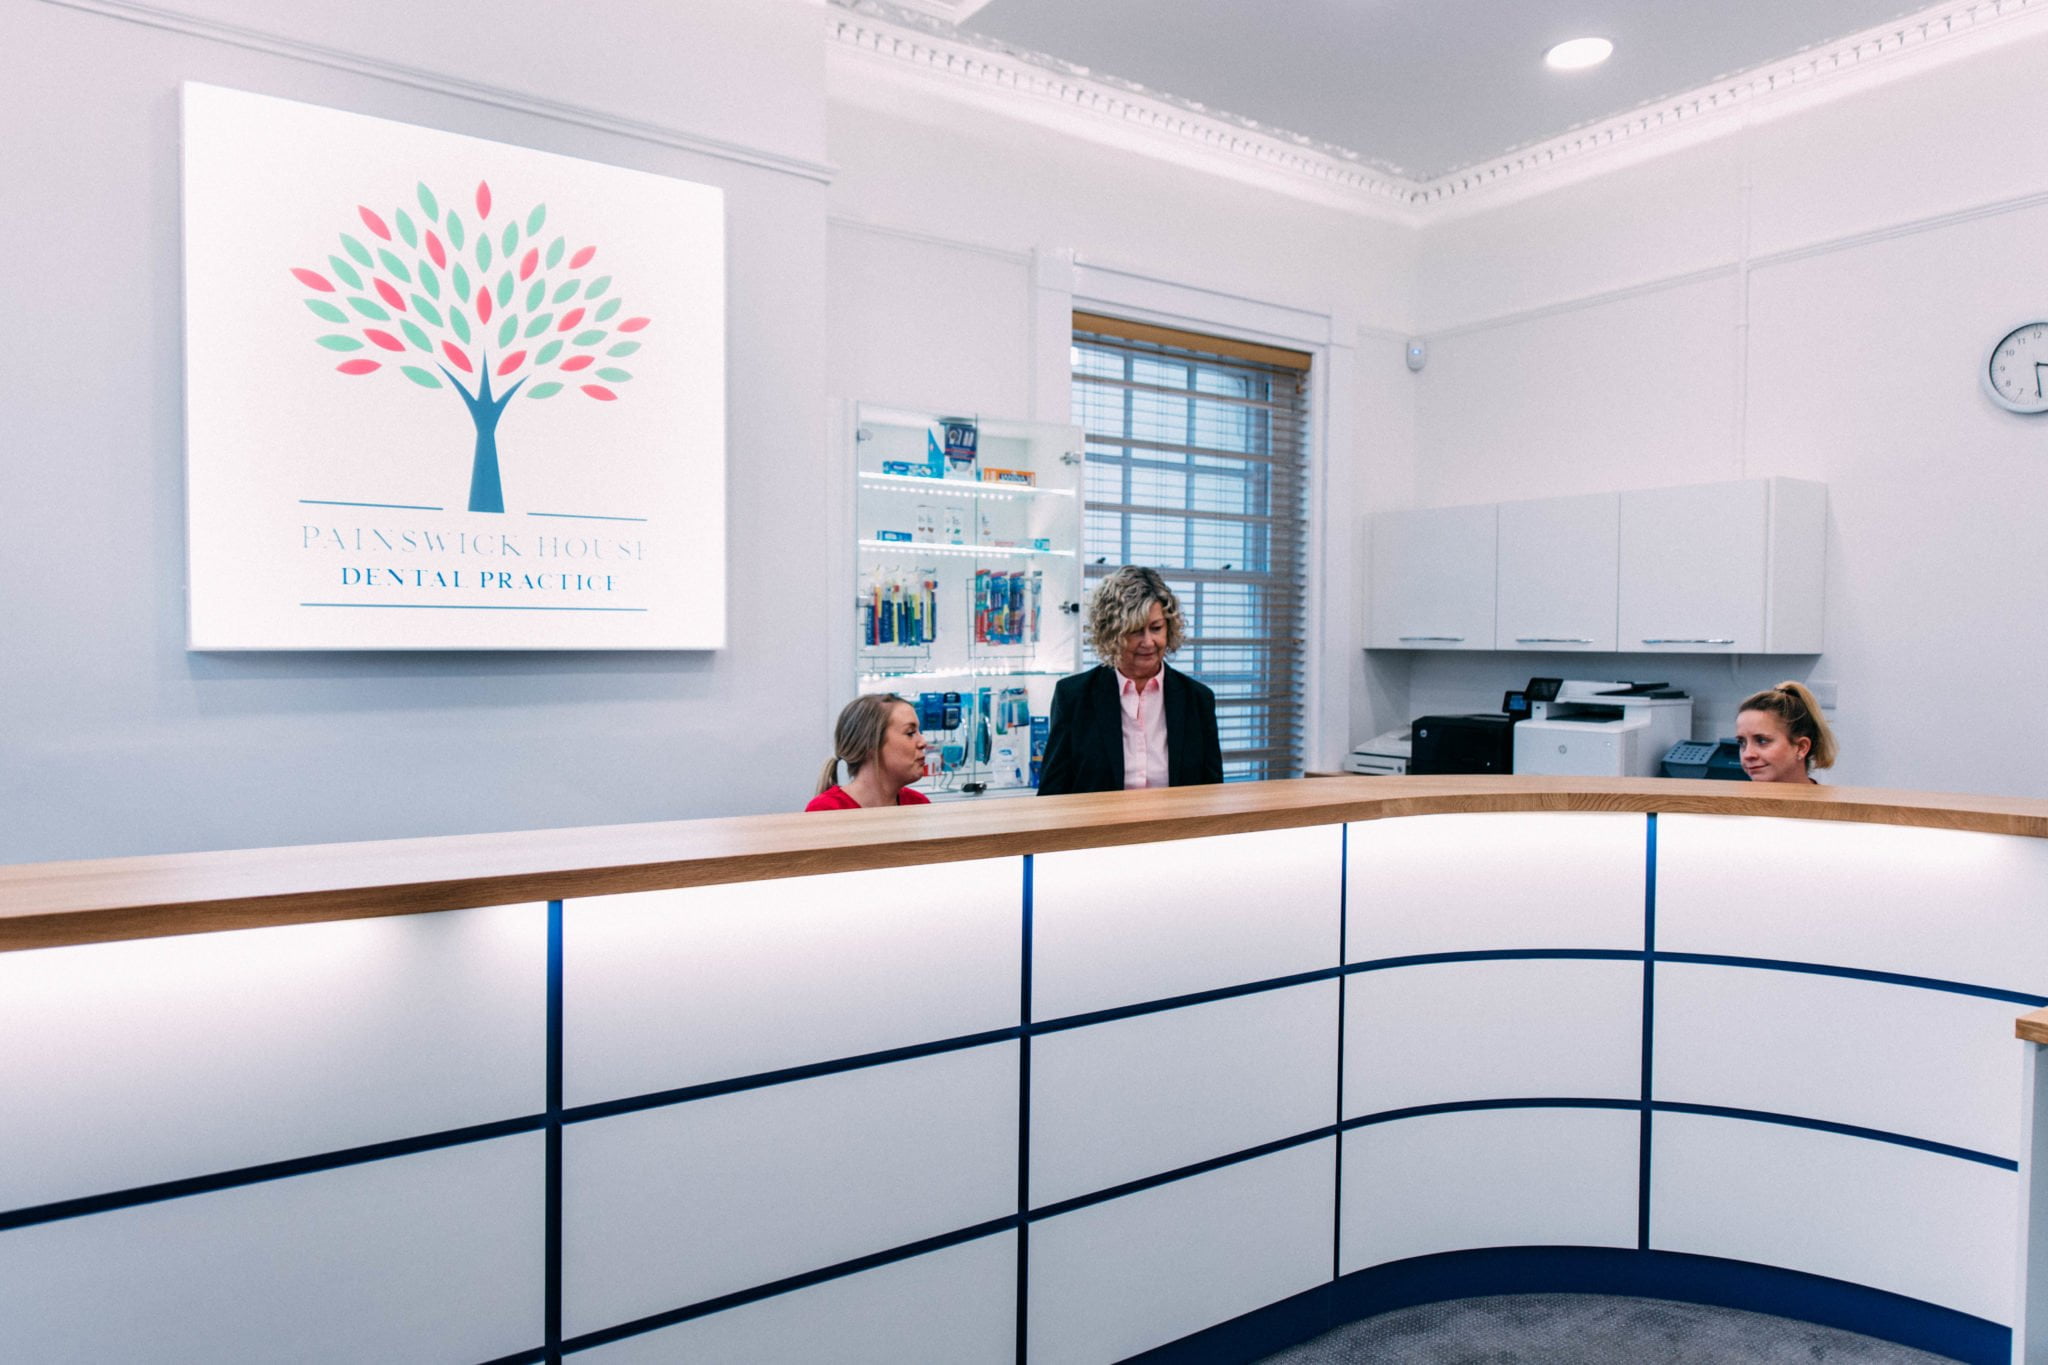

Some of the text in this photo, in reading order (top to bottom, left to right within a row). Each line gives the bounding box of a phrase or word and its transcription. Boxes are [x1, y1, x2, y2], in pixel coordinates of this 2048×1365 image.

[2033, 331, 2042, 339] 12
[2005, 349, 2015, 357] 10
[303, 525, 521, 556] PAINSWICK
[341, 567, 619, 592] DENTAL PRACTICE
